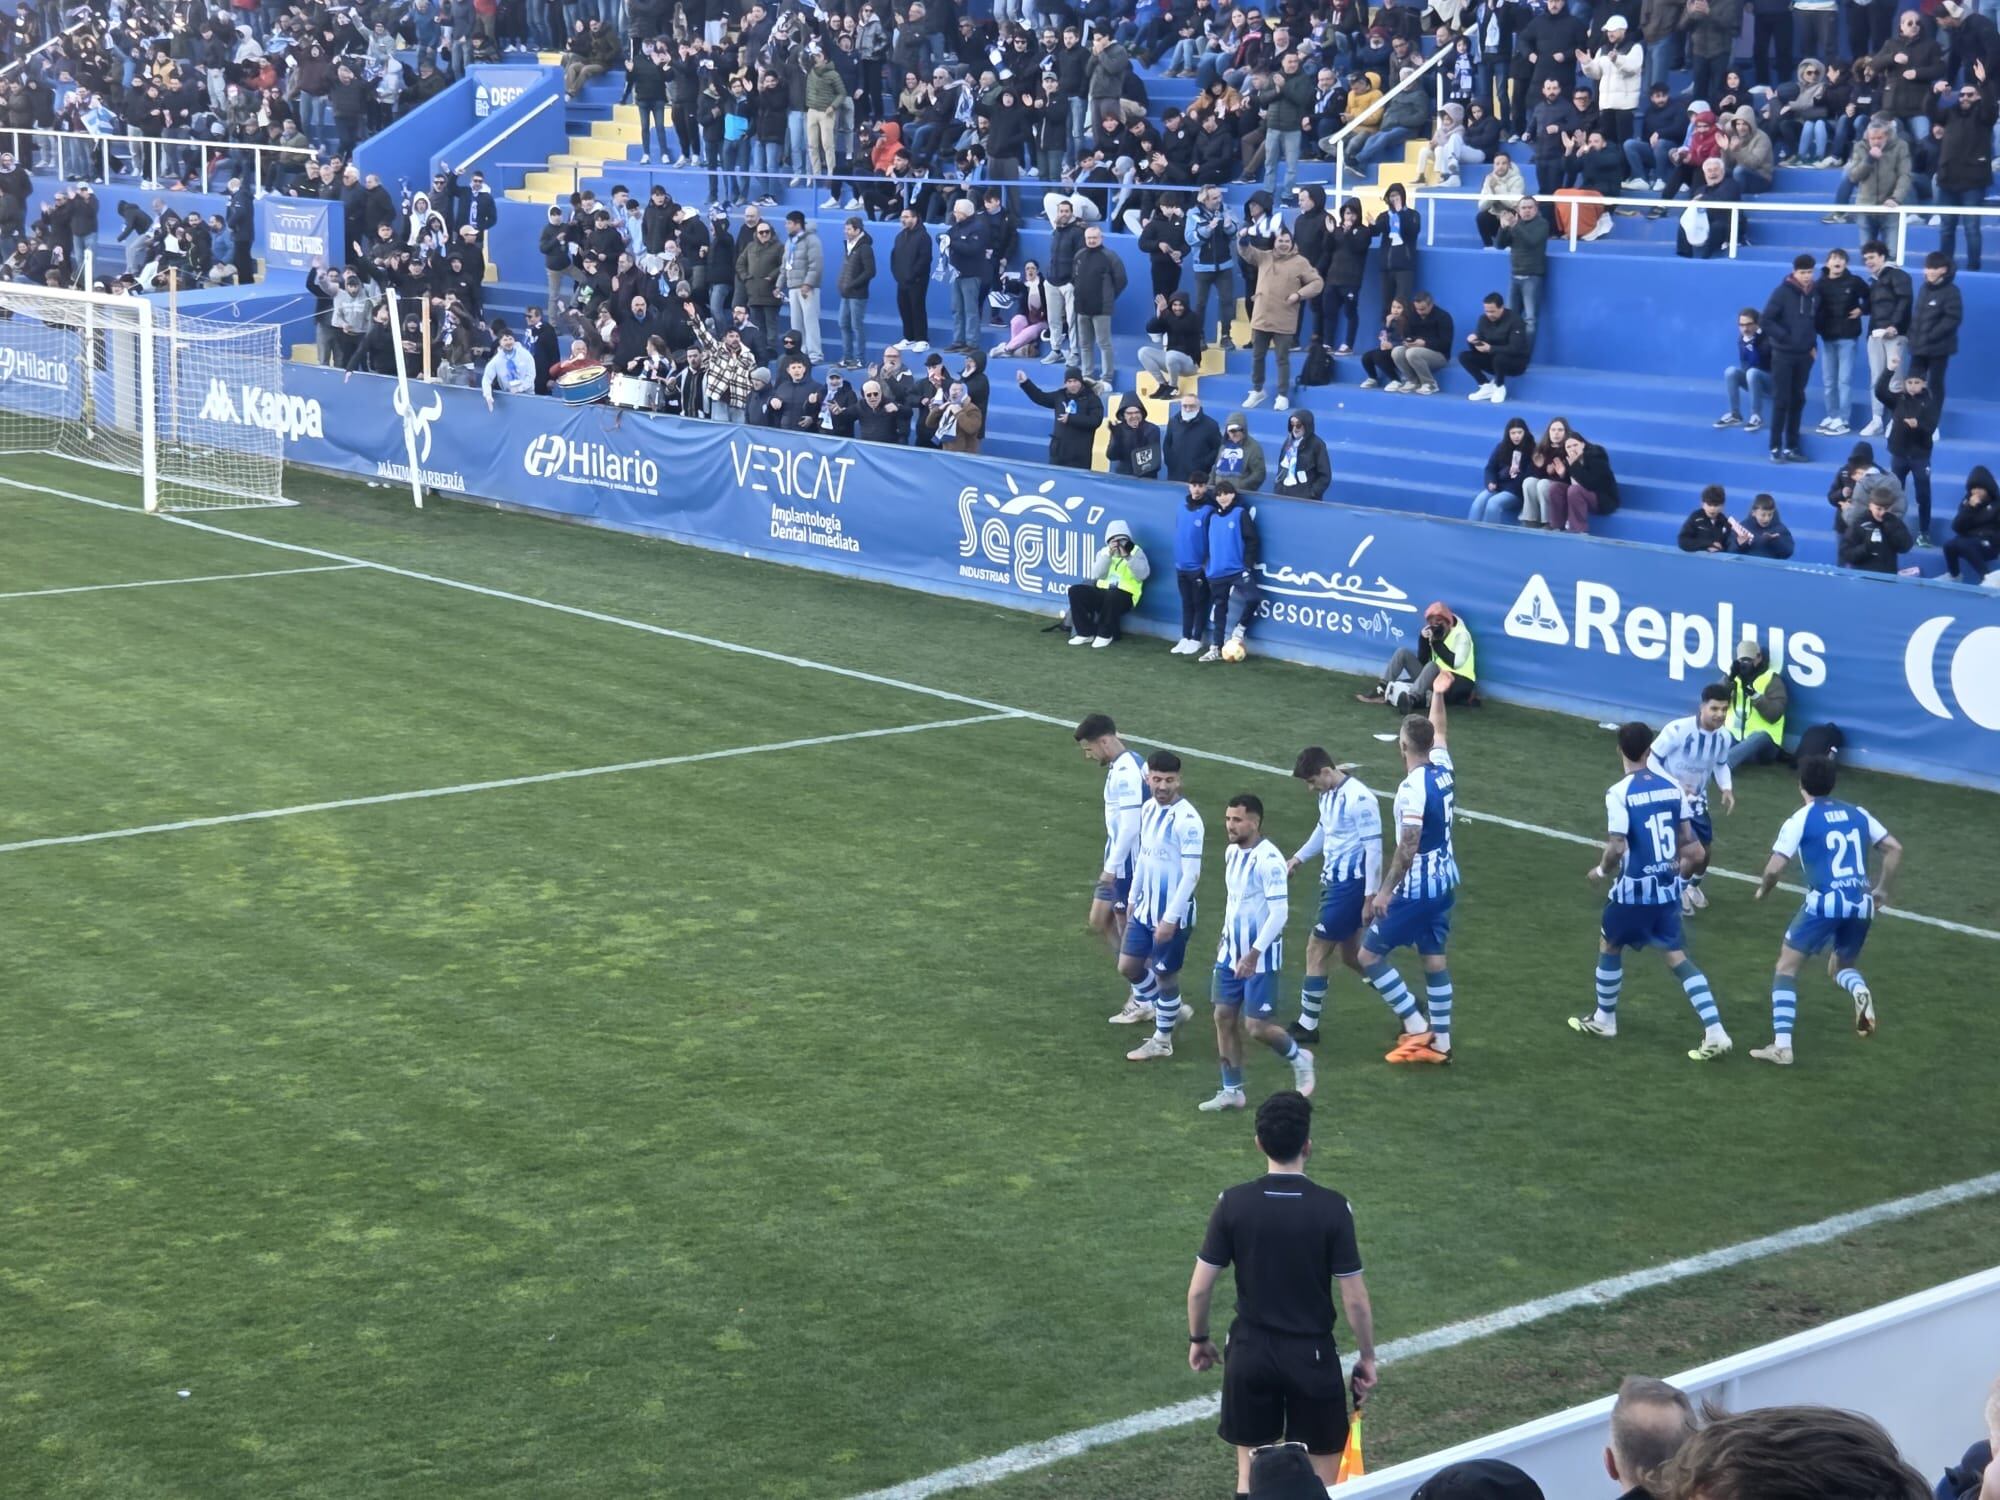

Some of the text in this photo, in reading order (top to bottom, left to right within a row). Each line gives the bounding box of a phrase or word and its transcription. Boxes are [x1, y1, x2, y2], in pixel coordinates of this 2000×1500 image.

[16, 350, 68, 384] Hilario
[242, 385, 325, 440] Kappa
[568, 440, 658, 487] Hilario
[730, 440, 856, 503] VERICAT
[770, 521, 860, 553] Dental Inmediata
[771, 503, 842, 532] Implantología
[959, 564, 1010, 585] INDUSTRIAS
[1254, 599, 1353, 634] sesores
[1574, 580, 1826, 688] Replus
[1644, 812, 1676, 862] 15
[1826, 828, 1865, 878] 21
